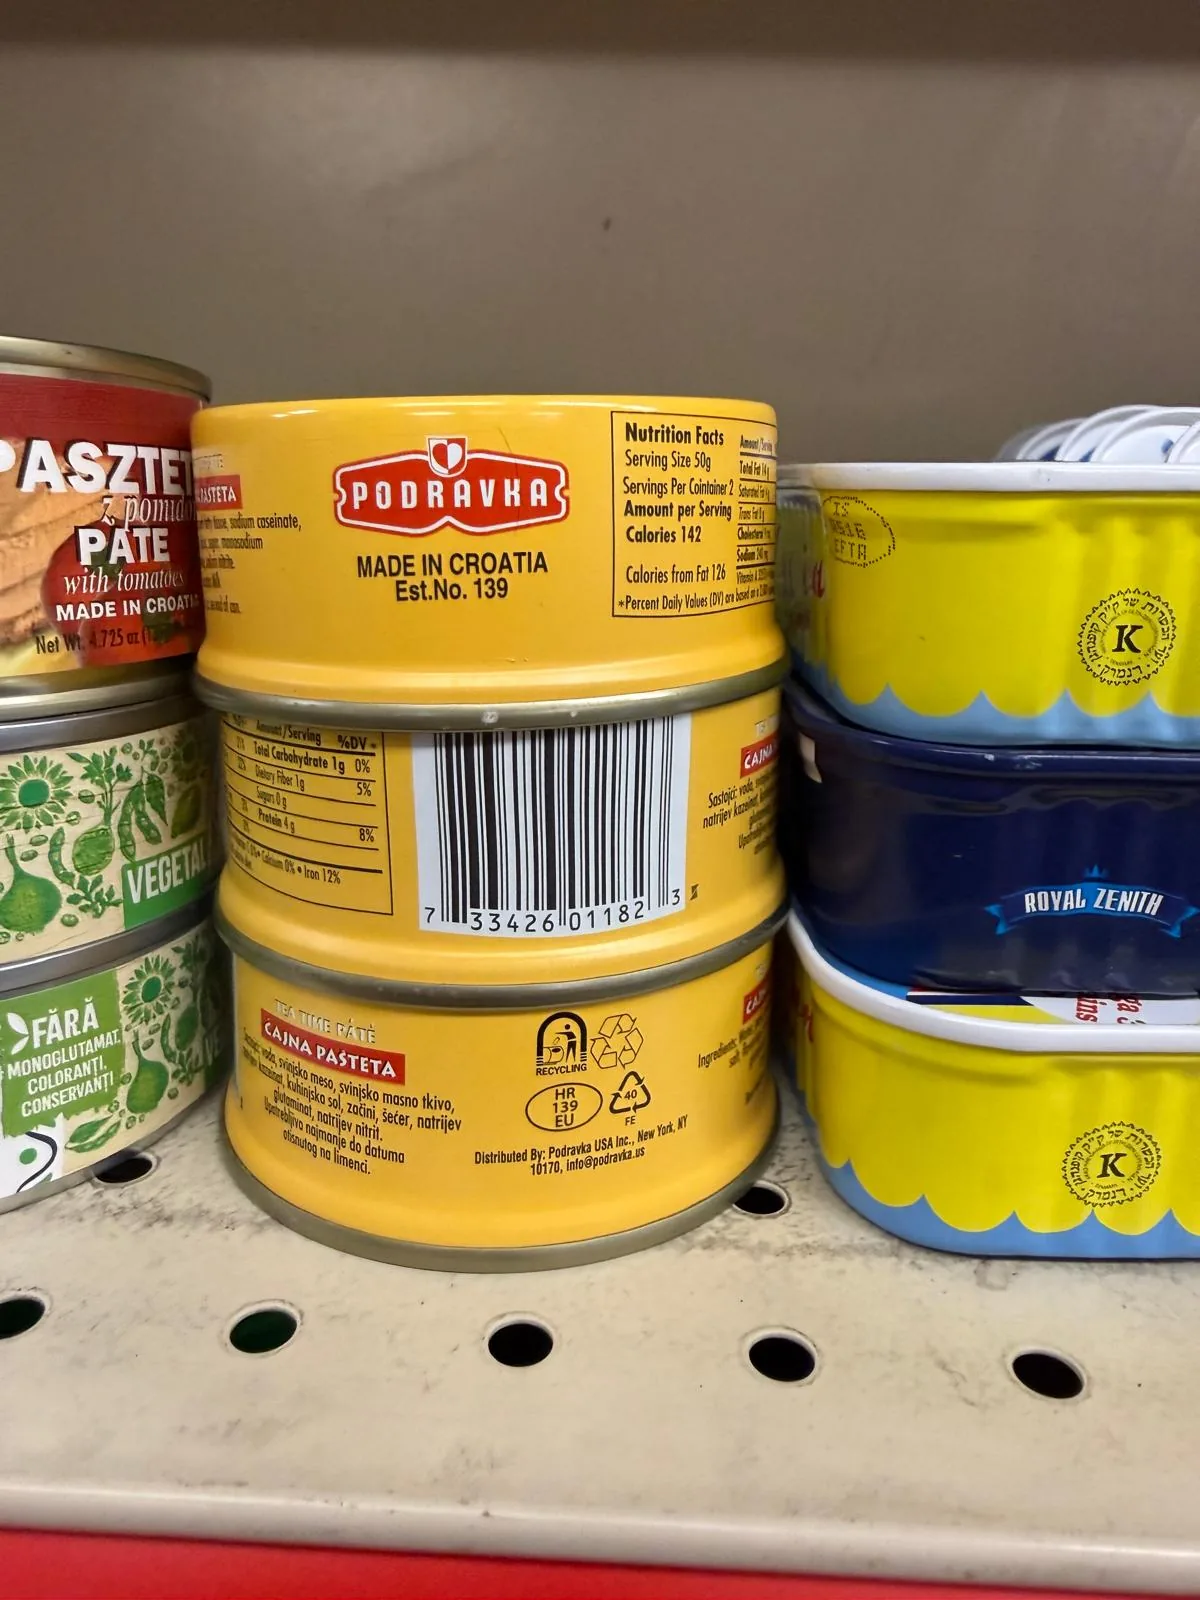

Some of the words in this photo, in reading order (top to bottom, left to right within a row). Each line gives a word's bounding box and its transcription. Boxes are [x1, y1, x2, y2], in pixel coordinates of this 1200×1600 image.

[625, 422, 691, 444] Nutrition
[696, 425, 724, 446] Facts
[625, 449, 668, 471] Serving
[671, 450, 691, 468] Size
[694, 451, 711, 472] 50g
[352, 478, 548, 510] PODRAVKA
[623, 476, 668, 499] Servings
[671, 477, 686, 495] Per
[729, 480, 734, 496] 2
[624, 499, 673, 517] Amount
[678, 502, 695, 522] per
[699, 500, 732, 521] Serving
[257, 513, 302, 532] caseinate,
[626, 525, 676, 543] Calories
[681, 525, 702, 543] 142
[357, 555, 416, 578] MADE
[422, 553, 442, 577] IN
[450, 551, 549, 576] CROATIA
[626, 564, 668, 584] Calories
[671, 565, 693, 584] from
[696, 564, 709, 582] Fat
[712, 564, 726, 581] 126
[64, 566, 109, 595] with
[395, 578, 467, 602] Est.No.
[473, 577, 509, 599] 139
[56, 601, 117, 622] MADE
[123, 599, 142, 617] IN
[662, 594, 683, 613] Daily
[685, 592, 708, 609] Values
[709, 591, 724, 607] (DV)
[725, 592, 735, 604] are
[36, 635, 60, 655] Net
[127, 632, 140, 646] oz
[1111, 624, 1144, 654] K
[253, 740, 270, 759] Total
[271, 745, 328, 770] Carbohydrate
[331, 755, 345, 775] 1g
[355, 759, 371, 774] 0%
[277, 769, 293, 787] Fiber
[356, 782, 372, 797] 5%
[258, 807, 282, 828] Protein
[703, 808, 732, 830] natrijev
[359, 828, 375, 843] 8%
[304, 869, 320, 882] Iron
[322, 868, 341, 886] 12%
[424, 906, 436, 924] 7
[470, 911, 555, 933] 33426
[569, 900, 645, 932] 01182
[672, 888, 681, 907] 3
[1024, 887, 1086, 914] ROYAL
[1093, 887, 1164, 916] ZENITH
[32, 996, 100, 1050] FĂRĂ
[274, 998, 296, 1020] TEA
[299, 1009, 331, 1034] TIME
[536, 1063, 588, 1077] RECYCLING
[279, 1056, 309, 1082] svinjsko
[310, 1073, 337, 1094] meso,
[339, 1081, 379, 1104] svinjsko
[382, 1092, 418, 1110] masno
[422, 1092, 455, 1114] tkivo,
[554, 1087, 576, 1101] HR
[624, 1088, 638, 1101] 40
[286, 1075, 326, 1106] kuhinjsko
[327, 1094, 344, 1114] sol,
[347, 1101, 379, 1124] začini,
[417, 1114, 462, 1135] natrijev
[552, 1099, 579, 1114] 139
[264, 1096, 304, 1131] Upotrebljivo
[305, 1122, 347, 1149] najmanje
[349, 1136, 362, 1154] do
[364, 1141, 406, 1164] datuma
[317, 1108, 353, 1135] natrijev
[355, 1122, 384, 1142] nitrit.
[554, 1114, 574, 1129] EU
[624, 1115, 636, 1126] FE
[474, 1147, 528, 1165] Distributed
[530, 1148, 546, 1163] By:
[548, 1141, 592, 1160] Podravka
[594, 1136, 614, 1152] USA
[615, 1135, 635, 1149] Inc.,
[637, 1127, 655, 1143] New
[657, 1121, 677, 1138] York,
[677, 1114, 689, 1129] NY
[283, 1127, 318, 1159] otisnutog
[320, 1146, 331, 1161] na
[333, 1149, 372, 1176] limenci.
[530, 1161, 564, 1177] 10170,
[566, 1146, 646, 1171] info@podravka.us
[1096, 1152, 1128, 1178] K
